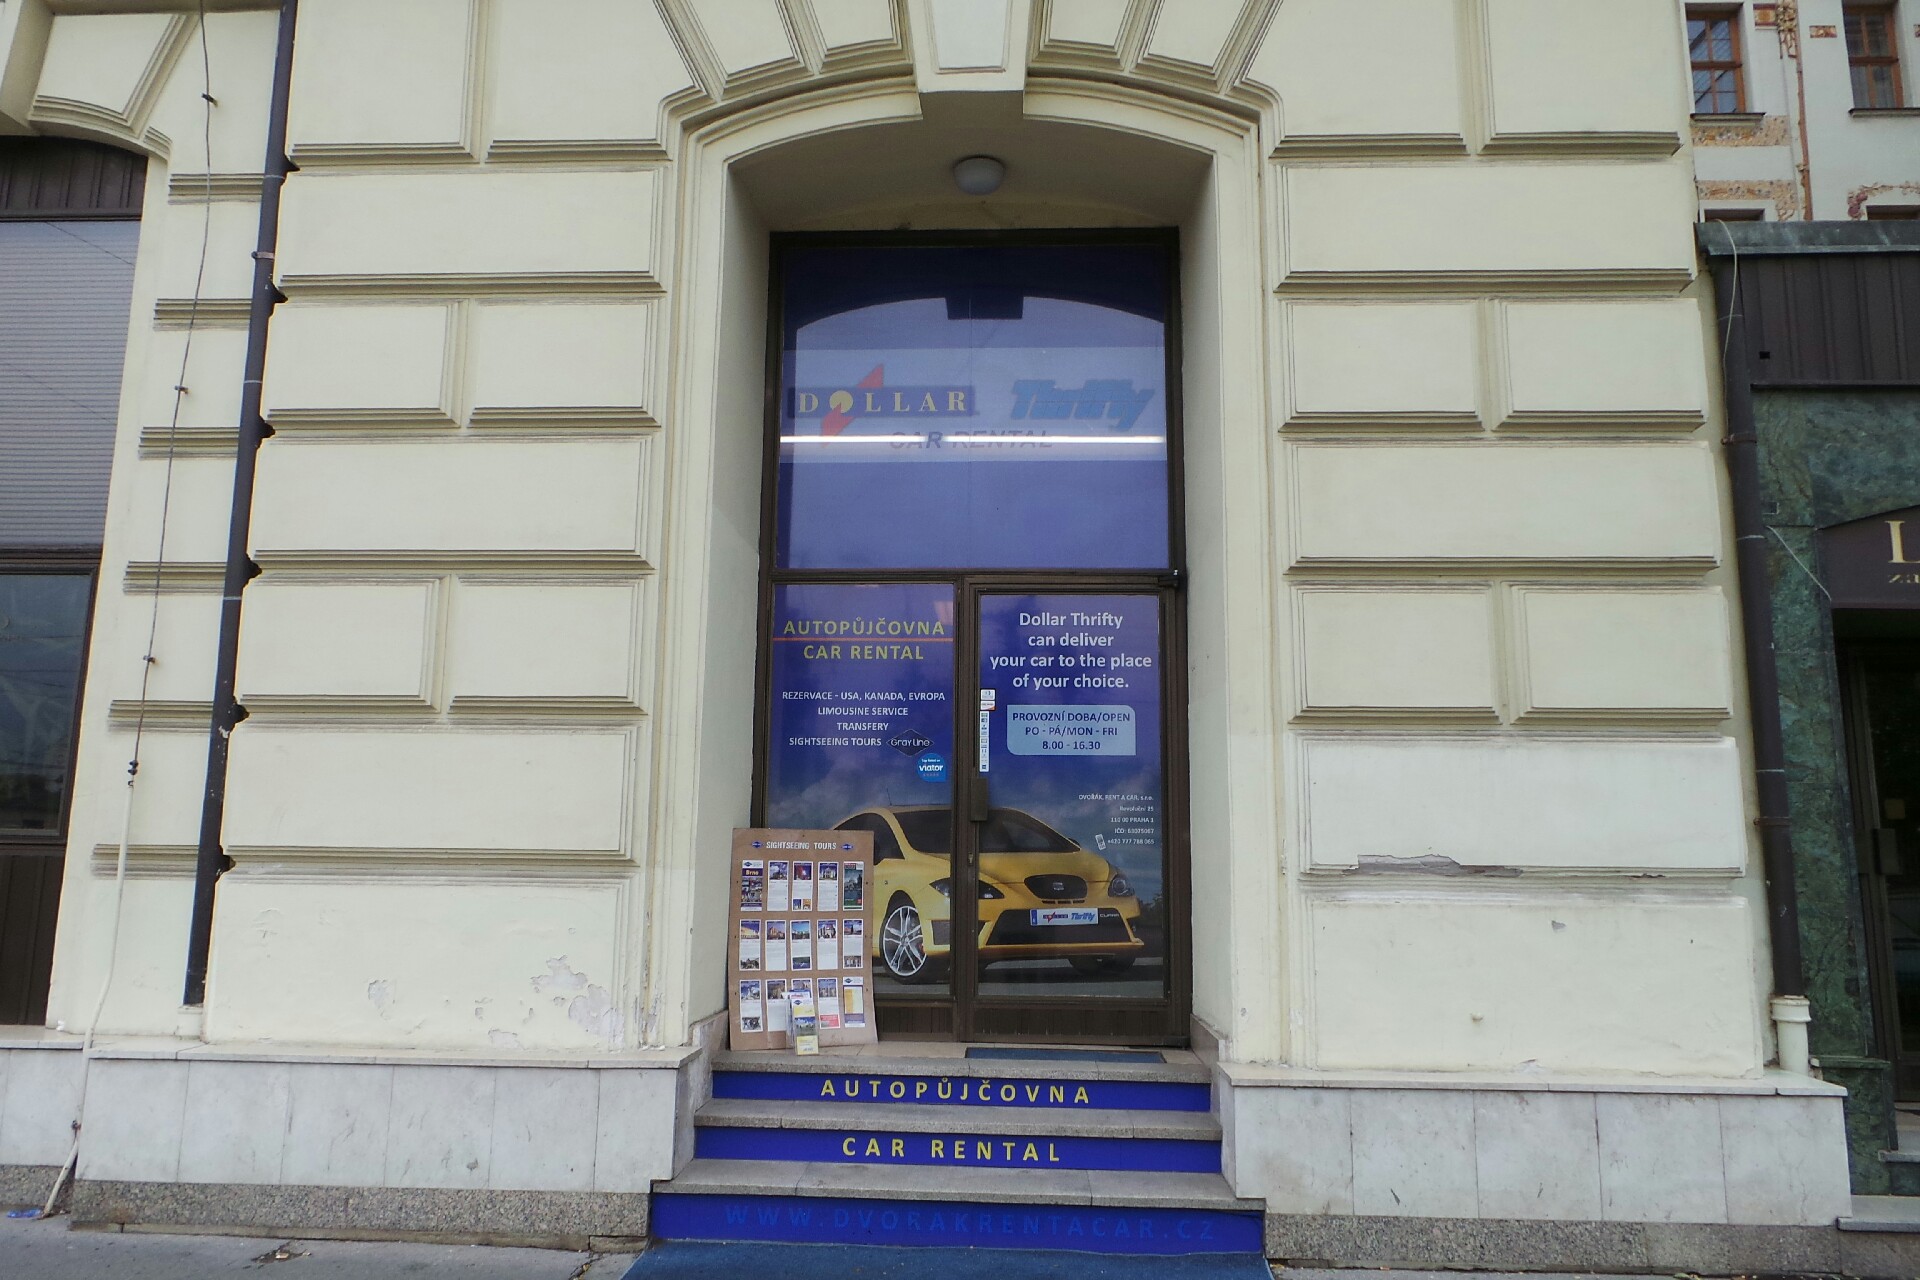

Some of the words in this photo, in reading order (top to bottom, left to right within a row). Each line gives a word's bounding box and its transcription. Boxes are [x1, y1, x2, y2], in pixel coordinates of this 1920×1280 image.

[798, 389, 967, 414] DOLLAR
[1011, 379, 1155, 432] Thrifty
[889, 431, 944, 449] CAR
[952, 430, 1053, 449] RENTAL
[783, 617, 945, 635] AUTOPŮJČOVNA
[1019, 612, 1066, 626] Dollar
[1071, 612, 1123, 629] Thrifty
[1028, 636, 1055, 647] can
[1059, 633, 1114, 647] deliver
[803, 645, 841, 660] CAR
[850, 645, 924, 660] RENTAL
[990, 656, 1026, 670] your
[1030, 656, 1054, 667] car
[1059, 655, 1075, 667] to
[1079, 653, 1106, 667] the
[1110, 653, 1152, 670] place
[1012, 674, 1030, 688] of
[1034, 677, 1070, 690] your
[1073, 674, 1129, 688] choice.
[782, 691, 833, 700] REZERVACE
[841, 691, 862, 702] USA,
[864, 692, 906, 702] KANADA,
[908, 692, 945, 701] EVROPA
[818, 707, 870, 716] LIMOUSINE
[871, 707, 909, 716] SERVICE
[1012, 711, 1065, 721] PROVOZNÍ
[1067, 712, 1130, 723] DOBA/OPEN
[836, 722, 889, 731] TRANSFERY
[1025, 727, 1039, 736] PO
[1049, 725, 1093, 737] PÁ/MON
[1102, 727, 1118, 736] FRI
[789, 737, 849, 746] SIGHTSEEING
[851, 738, 882, 746] TOURS
[1042, 741, 1064, 750] 8.00
[1073, 741, 1101, 750] 16.30
[919, 764, 944, 772] viator
[766, 841, 810, 850] SIGHTSEEING
[814, 842, 837, 850] TOURS
[820, 1076, 1091, 1105] AUTOPŮJČOVNA
[842, 1136, 906, 1159] CAR
[930, 1138, 1061, 1162] RENTAL
[725, 1204, 1214, 1240] WWW.DVORAKRENTACAR.CZ
